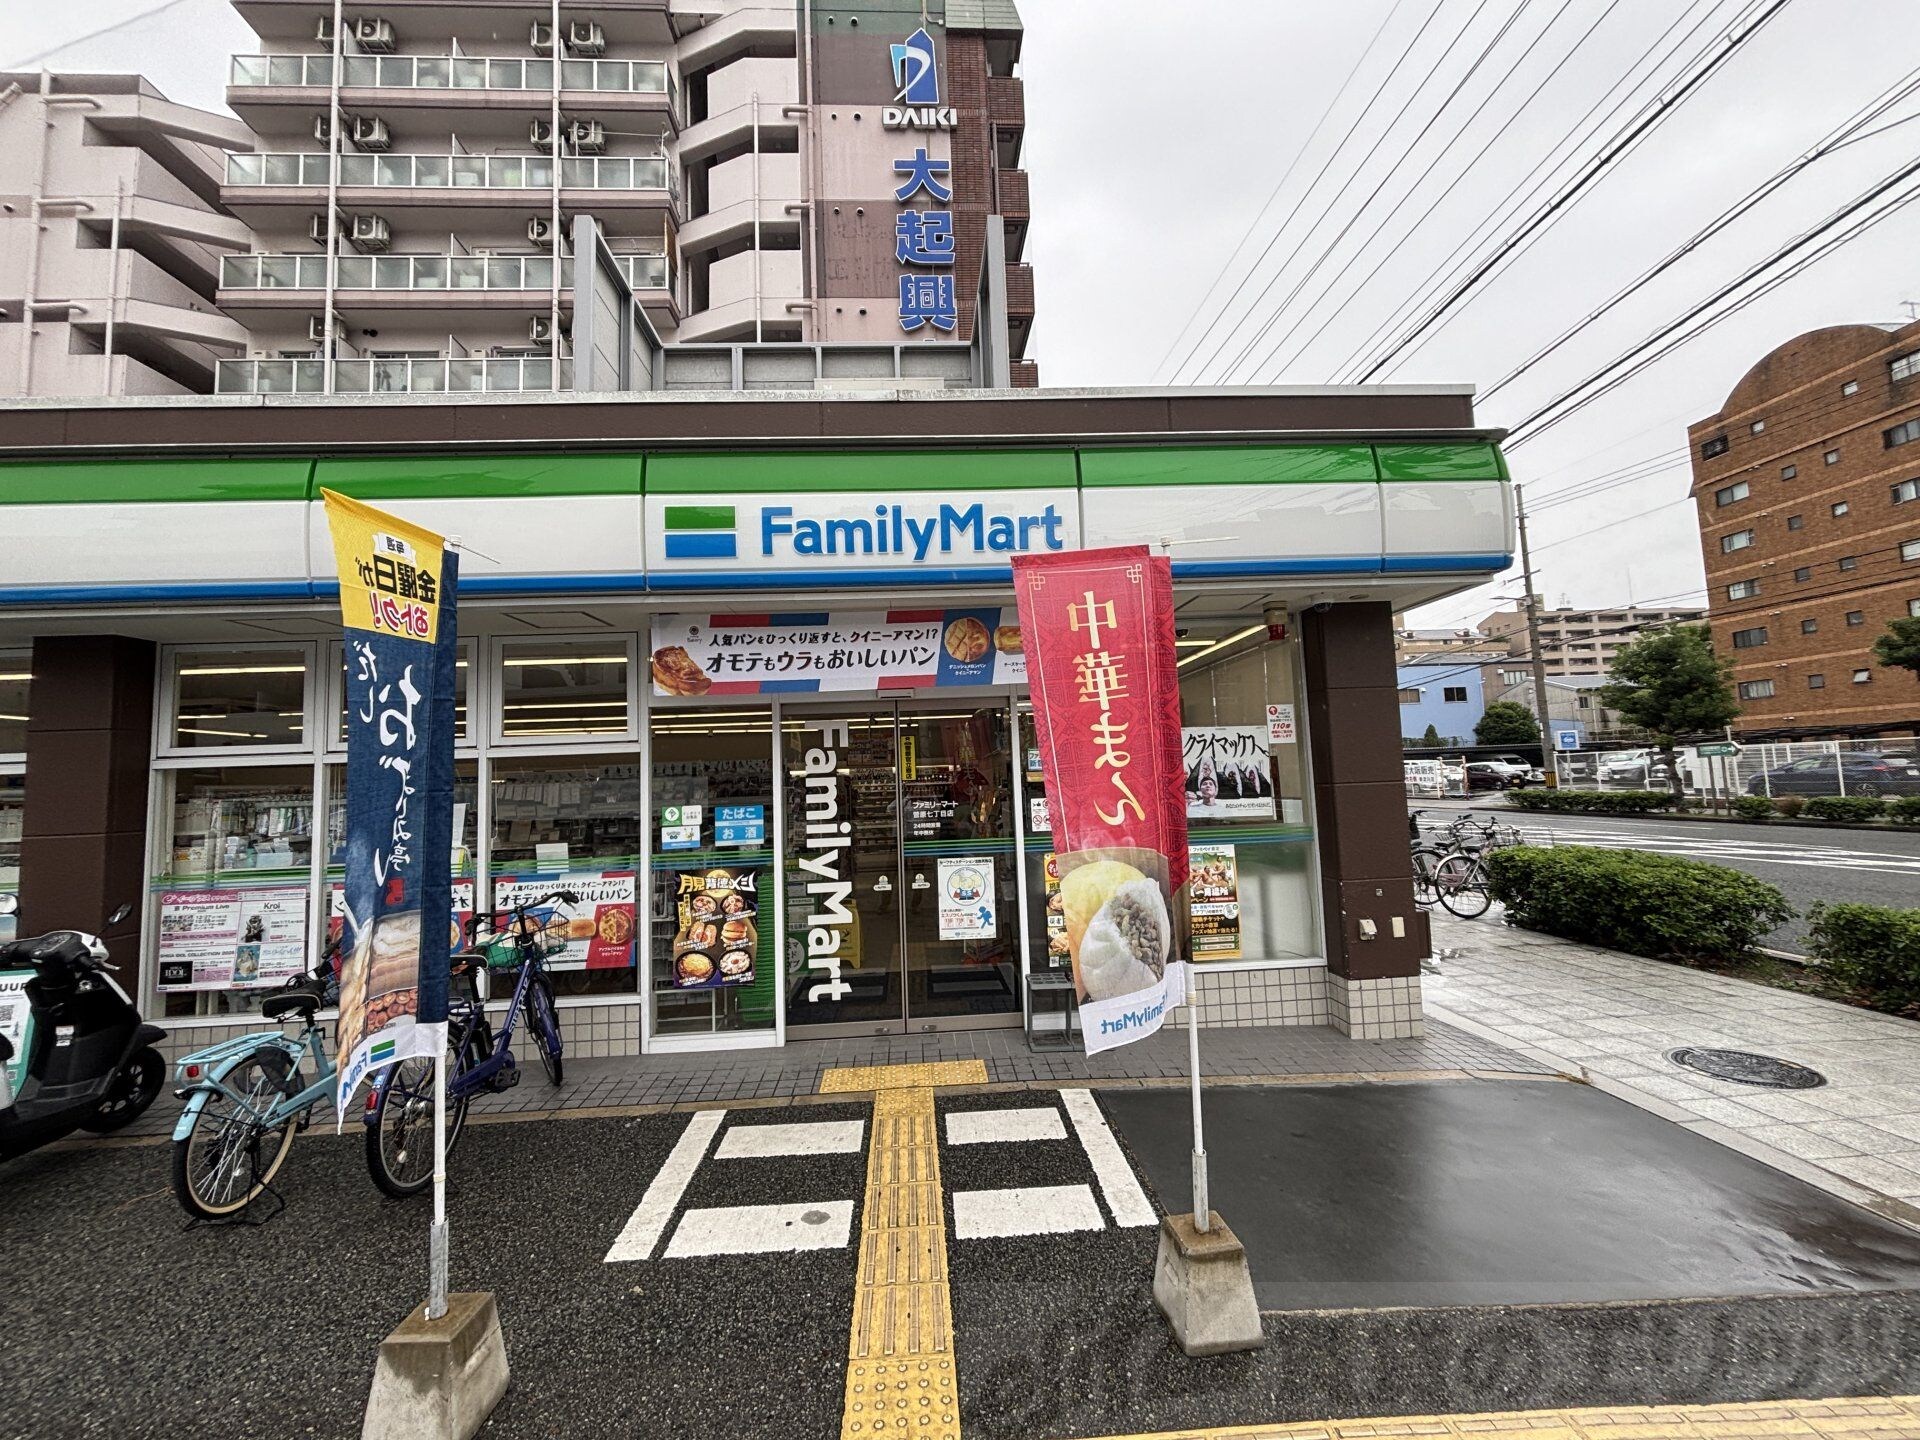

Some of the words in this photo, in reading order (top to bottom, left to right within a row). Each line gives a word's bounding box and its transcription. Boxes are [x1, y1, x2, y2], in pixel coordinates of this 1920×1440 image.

[883, 107, 958, 128] DAIKI
[893, 148, 957, 341] 大起興
[761, 503, 1064, 562] FamilyMart
[705, 645, 936, 673] オモテもウラもおいしいパン
[722, 807, 756, 819] たばこ
[912, 800, 958, 809] ファミリーマート
[799, 719, 853, 1003] FamilyMart
